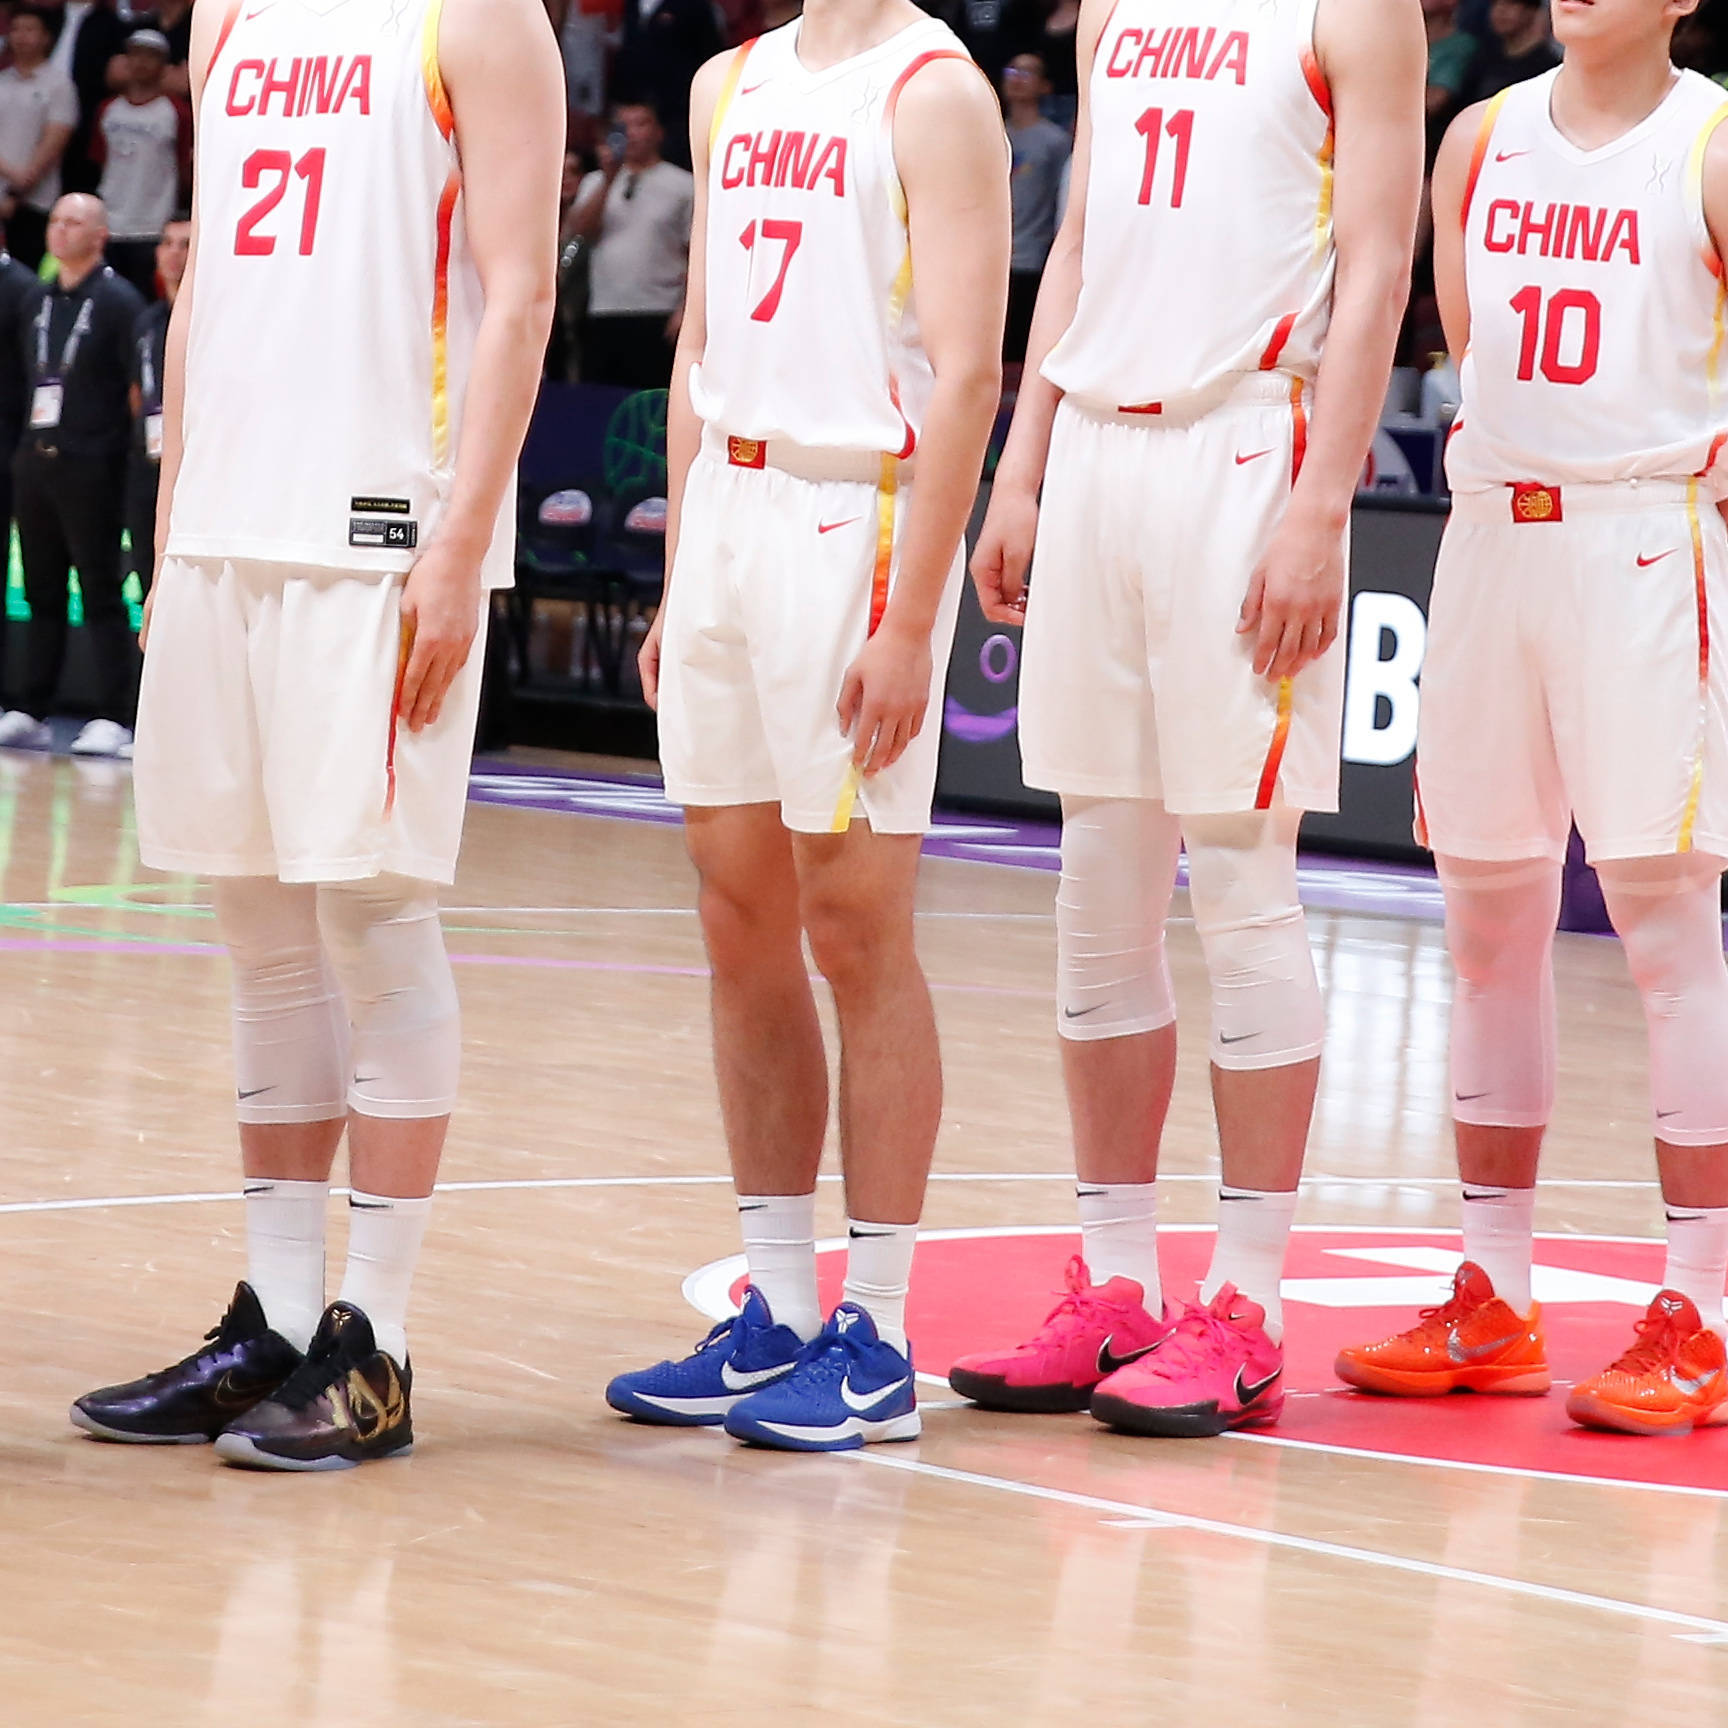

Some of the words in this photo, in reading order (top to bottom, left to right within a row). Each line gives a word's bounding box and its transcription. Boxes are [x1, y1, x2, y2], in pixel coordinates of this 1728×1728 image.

[225, 54, 372, 118] CHINA
[1106, 27, 1250, 86] CHINA
[721, 130, 847, 198] CHINA
[1135, 107, 1195, 209] 11
[233, 147, 327, 256] 21
[1483, 199, 1641, 265] CHINA
[738, 219, 803, 323] 17
[1508, 285, 1602, 386] 10
[388, 527, 405, 541] 54
